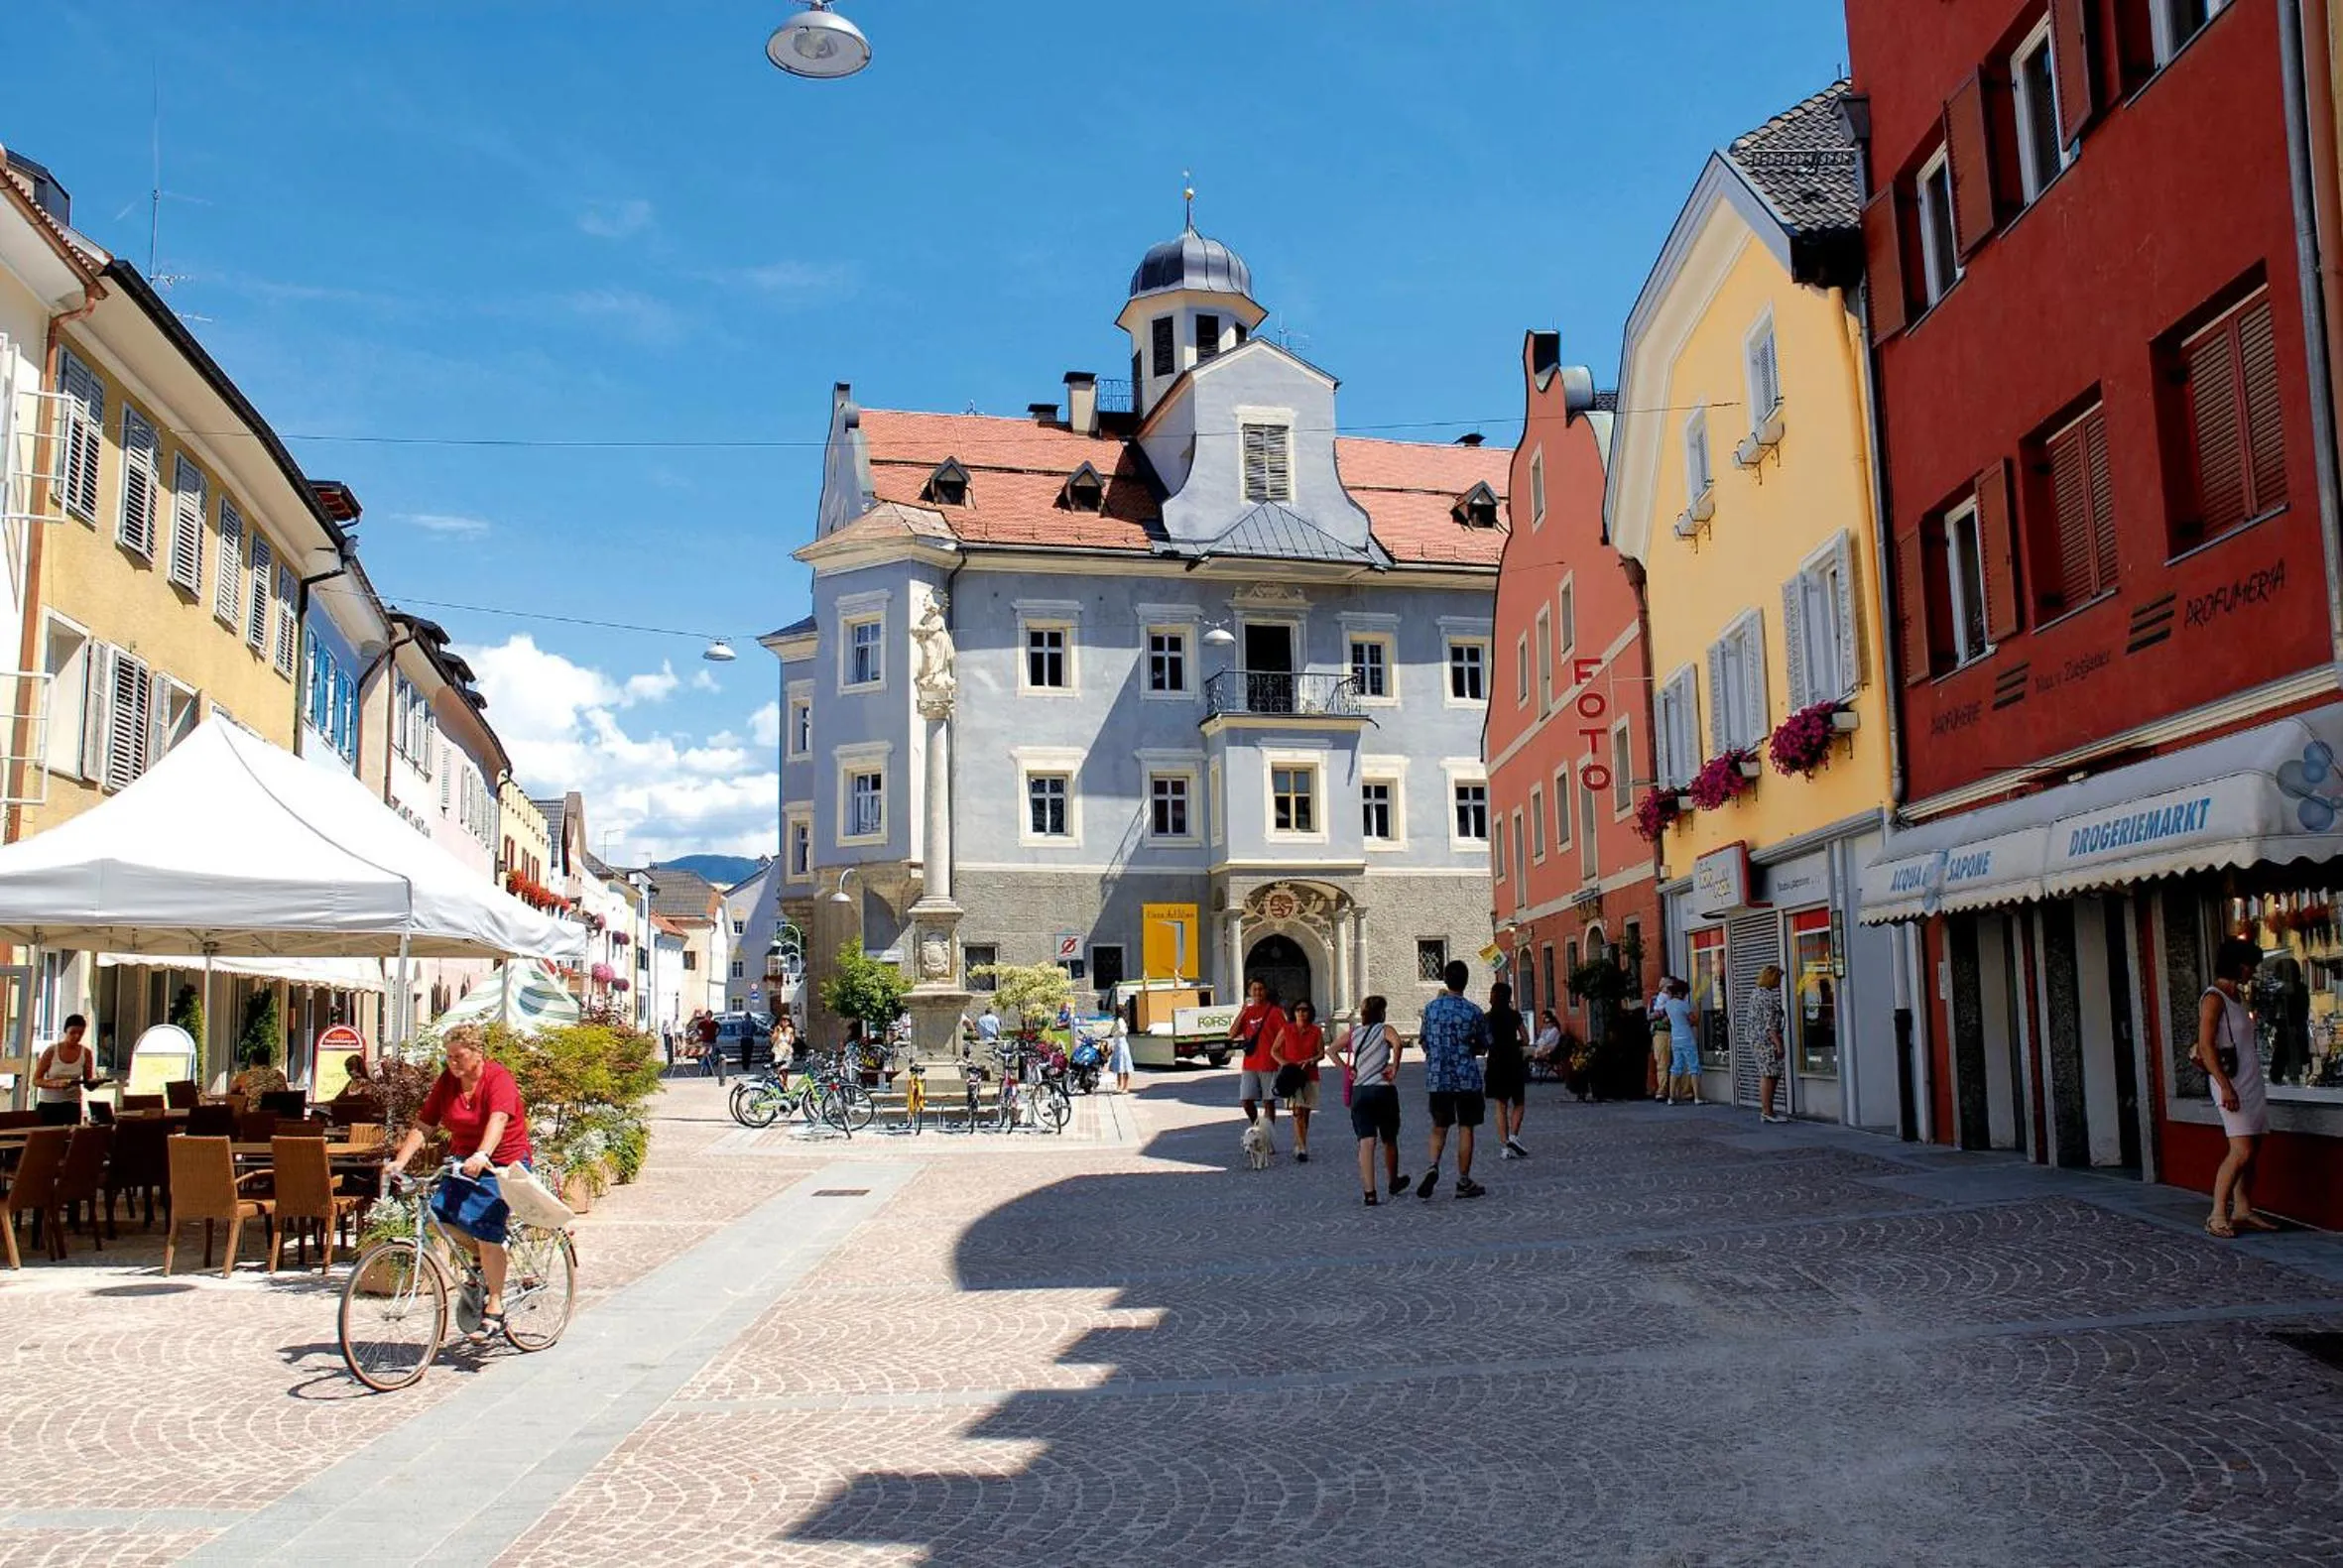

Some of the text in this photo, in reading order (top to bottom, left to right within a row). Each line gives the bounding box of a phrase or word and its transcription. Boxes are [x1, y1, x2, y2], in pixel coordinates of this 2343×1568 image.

[2184, 557, 2286, 630] PROFUMERIA
[1573, 659, 1611, 790] FOTO
[2068, 797, 2212, 857] DROGERIEMARKT
[1890, 864, 1922, 892] ACQUA
[1947, 850, 1993, 882] SAPONE
[1197, 1016, 1233, 1028] FORST
